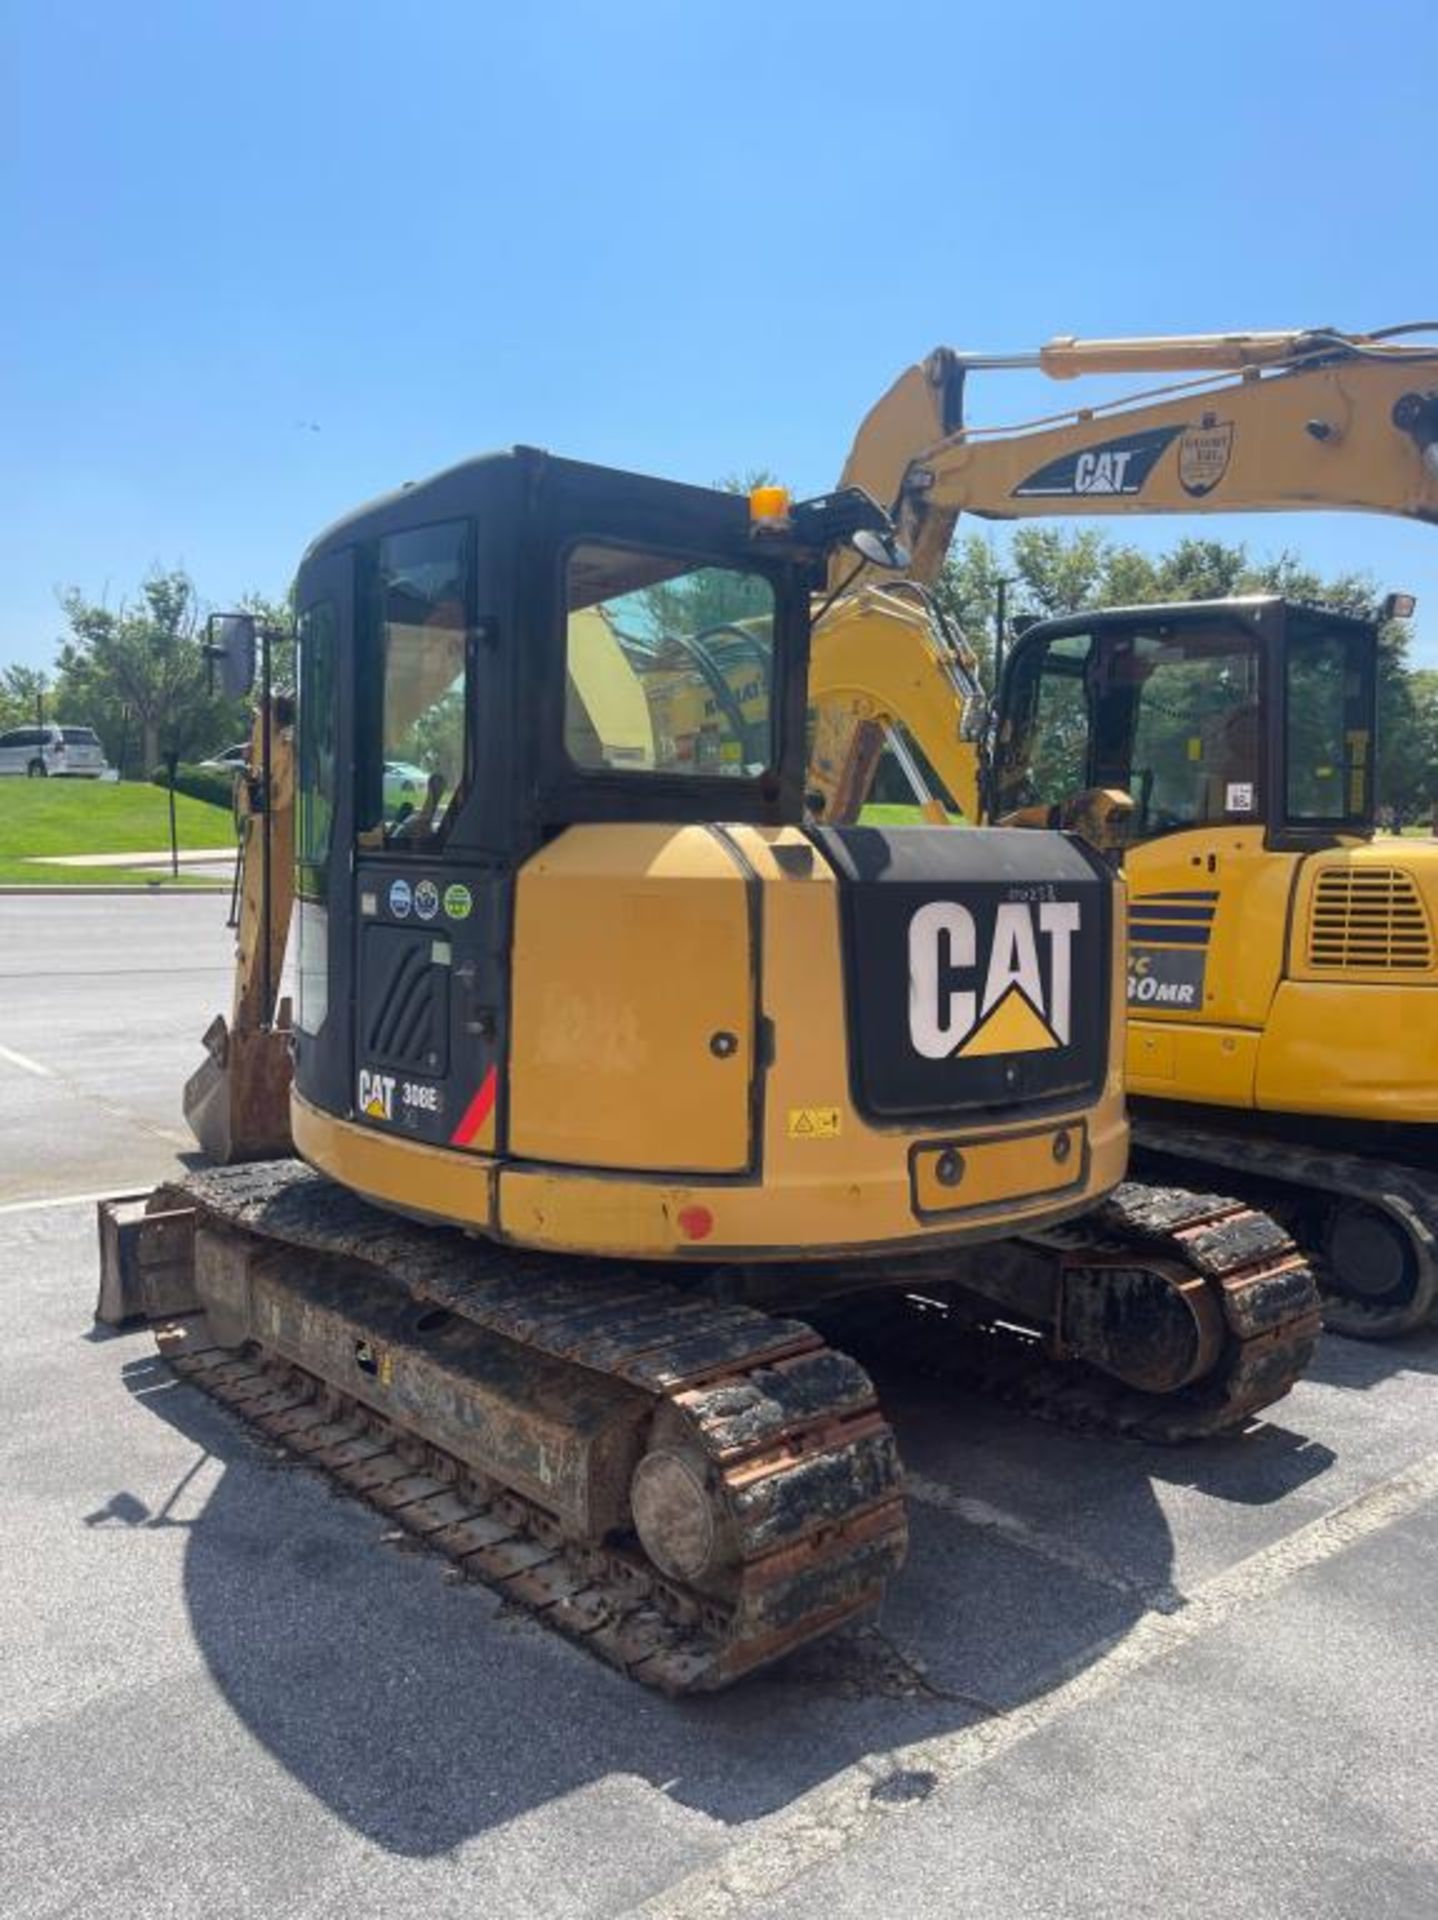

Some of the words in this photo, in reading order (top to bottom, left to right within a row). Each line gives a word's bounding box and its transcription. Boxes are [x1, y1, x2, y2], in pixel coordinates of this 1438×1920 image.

[1075, 451, 1131, 493] CAT
[908, 901, 1081, 1059] CAT
[359, 1069, 396, 1120] CAT
